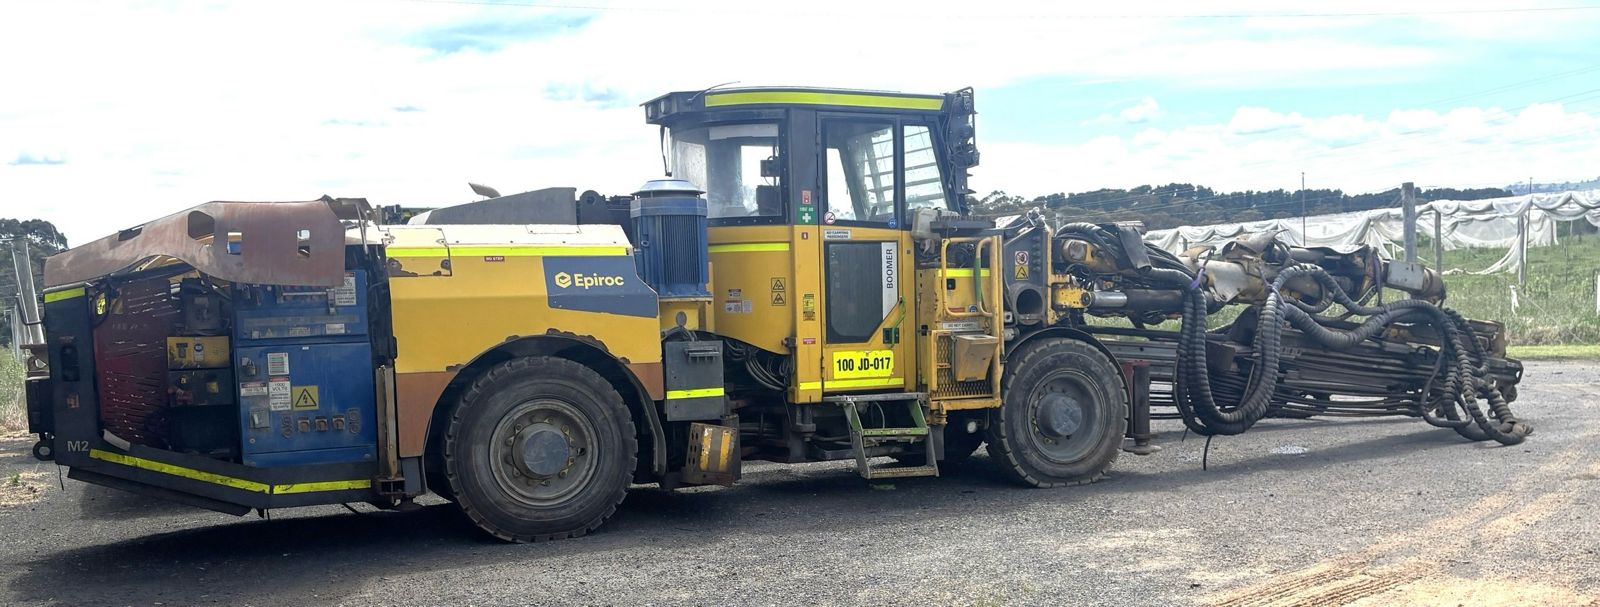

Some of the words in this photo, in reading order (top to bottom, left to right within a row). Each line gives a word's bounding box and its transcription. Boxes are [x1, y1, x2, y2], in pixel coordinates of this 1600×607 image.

[885, 248, 894, 289] BOOMER
[574, 273, 624, 289] Epiroc
[836, 358, 854, 372] 100
[857, 356, 891, 371] JD-017
[67, 440, 89, 452] M2
